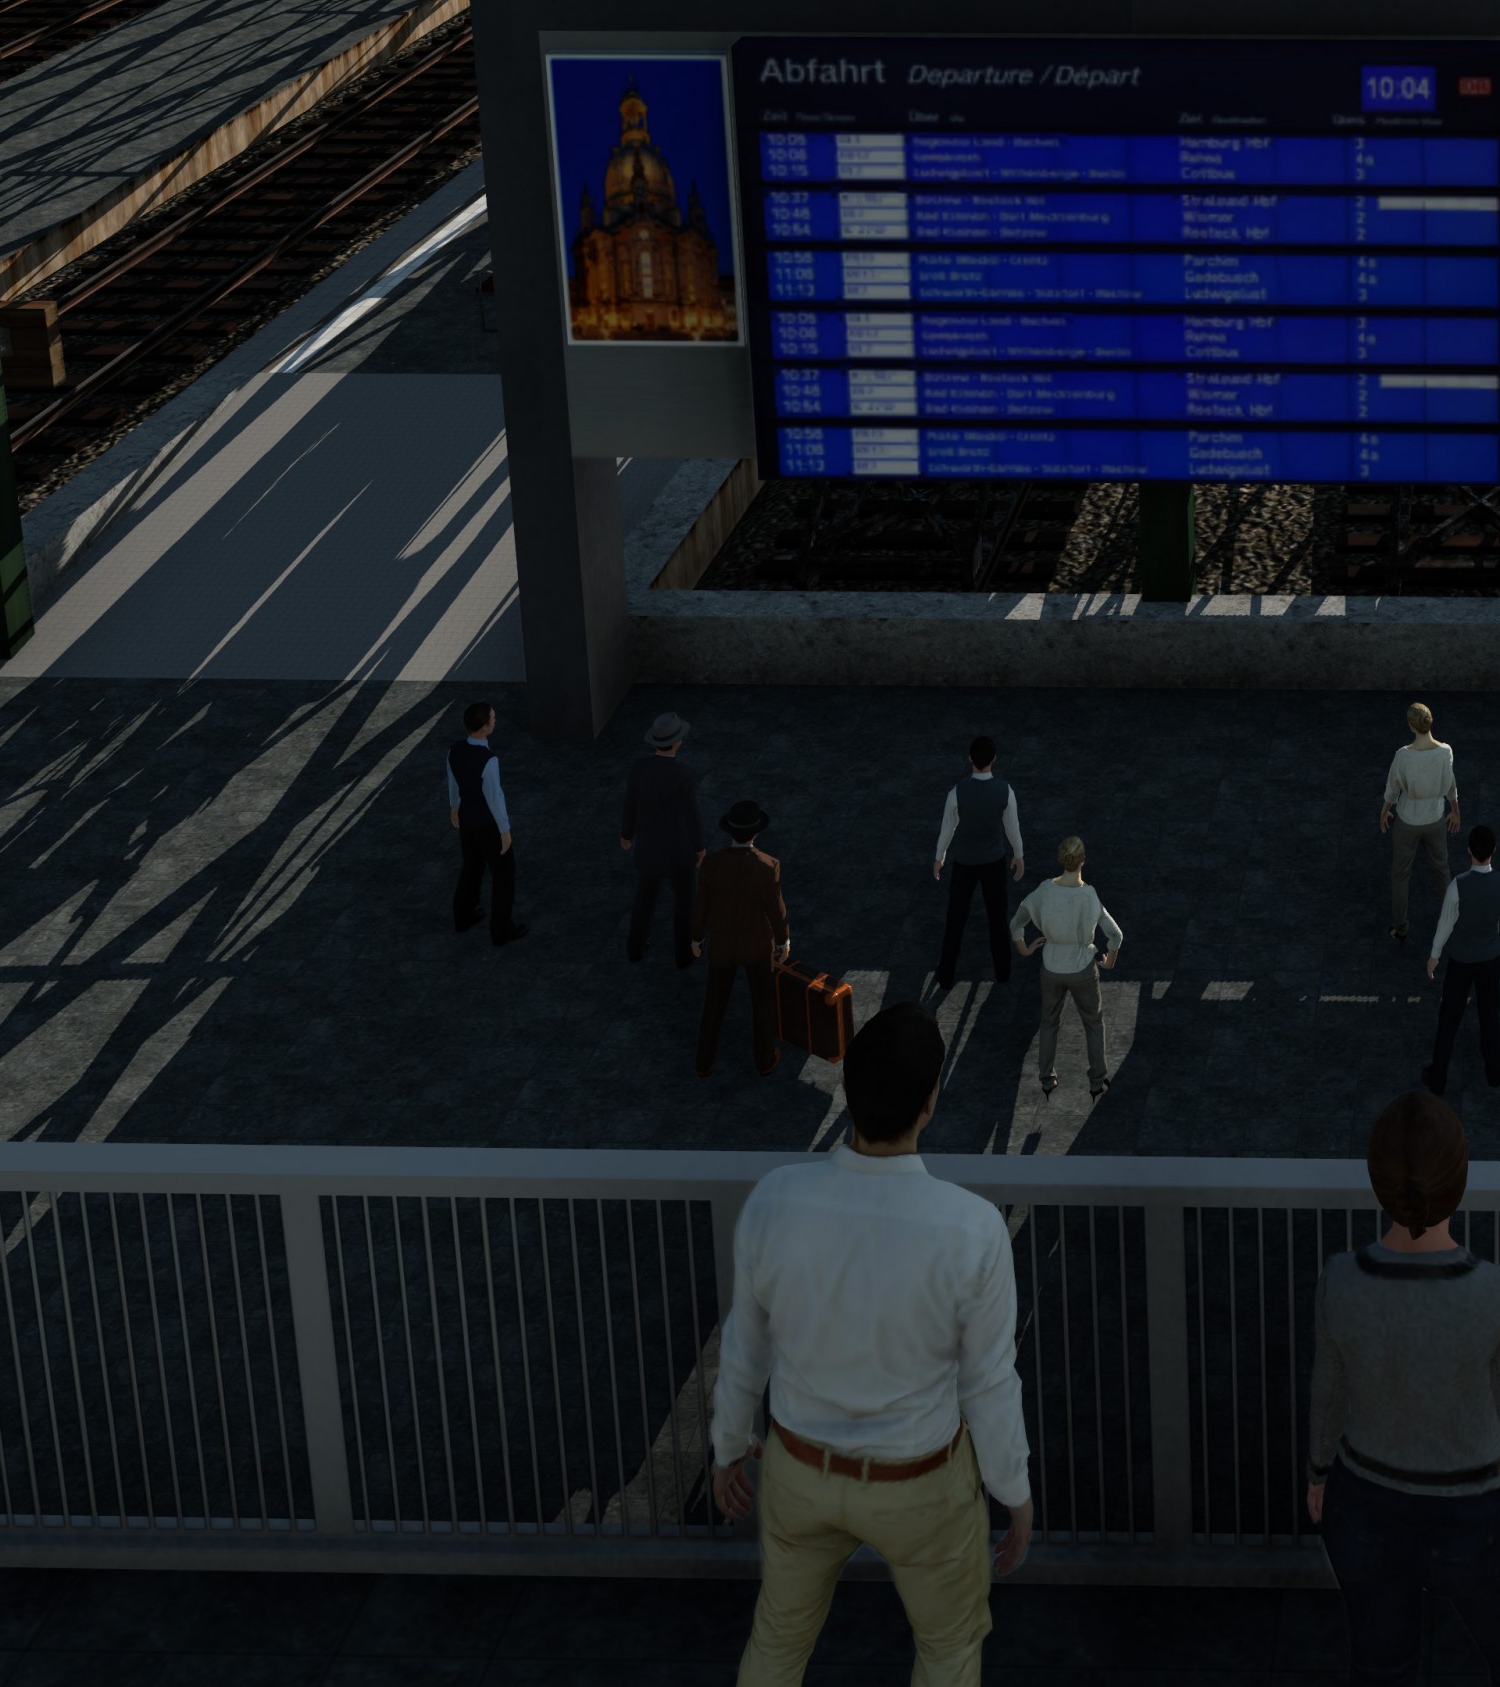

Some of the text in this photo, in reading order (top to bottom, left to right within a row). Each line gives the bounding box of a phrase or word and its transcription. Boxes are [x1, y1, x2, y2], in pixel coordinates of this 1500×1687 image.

[759, 57, 887, 86] Abfahrt
[907, 64, 1034, 89] Departure
[1366, 76, 1431, 100] 10:04
[1180, 167, 1235, 180] Cottbus
[1185, 346, 1239, 358] Cottbus
